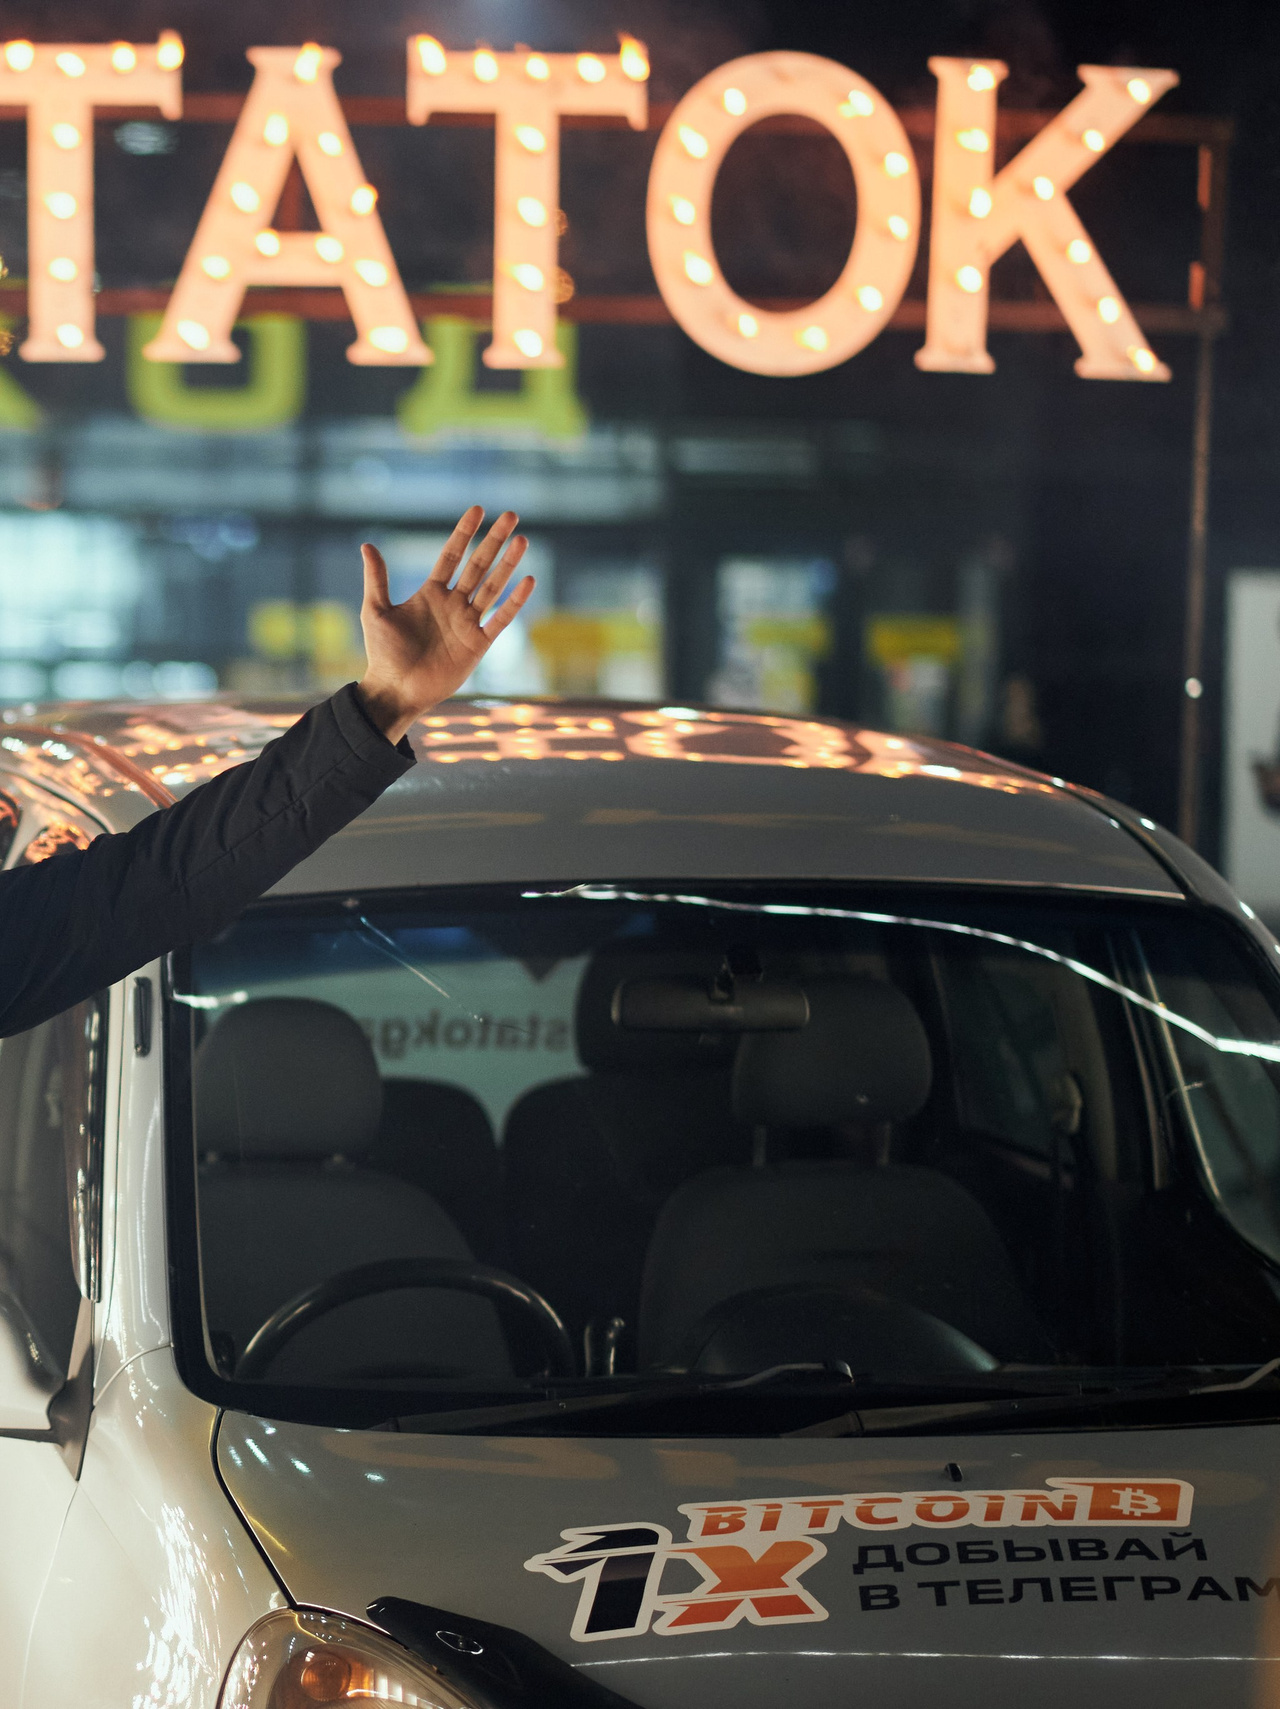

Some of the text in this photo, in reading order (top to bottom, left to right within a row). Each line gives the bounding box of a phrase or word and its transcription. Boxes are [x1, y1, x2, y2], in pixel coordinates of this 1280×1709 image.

[692, 1494, 1079, 1538] BITCOIN
[852, 1531, 1208, 1575] ДОБЫВАЙ
[858, 1575, 1280, 1611] В ТЕЛЕГРАМ
